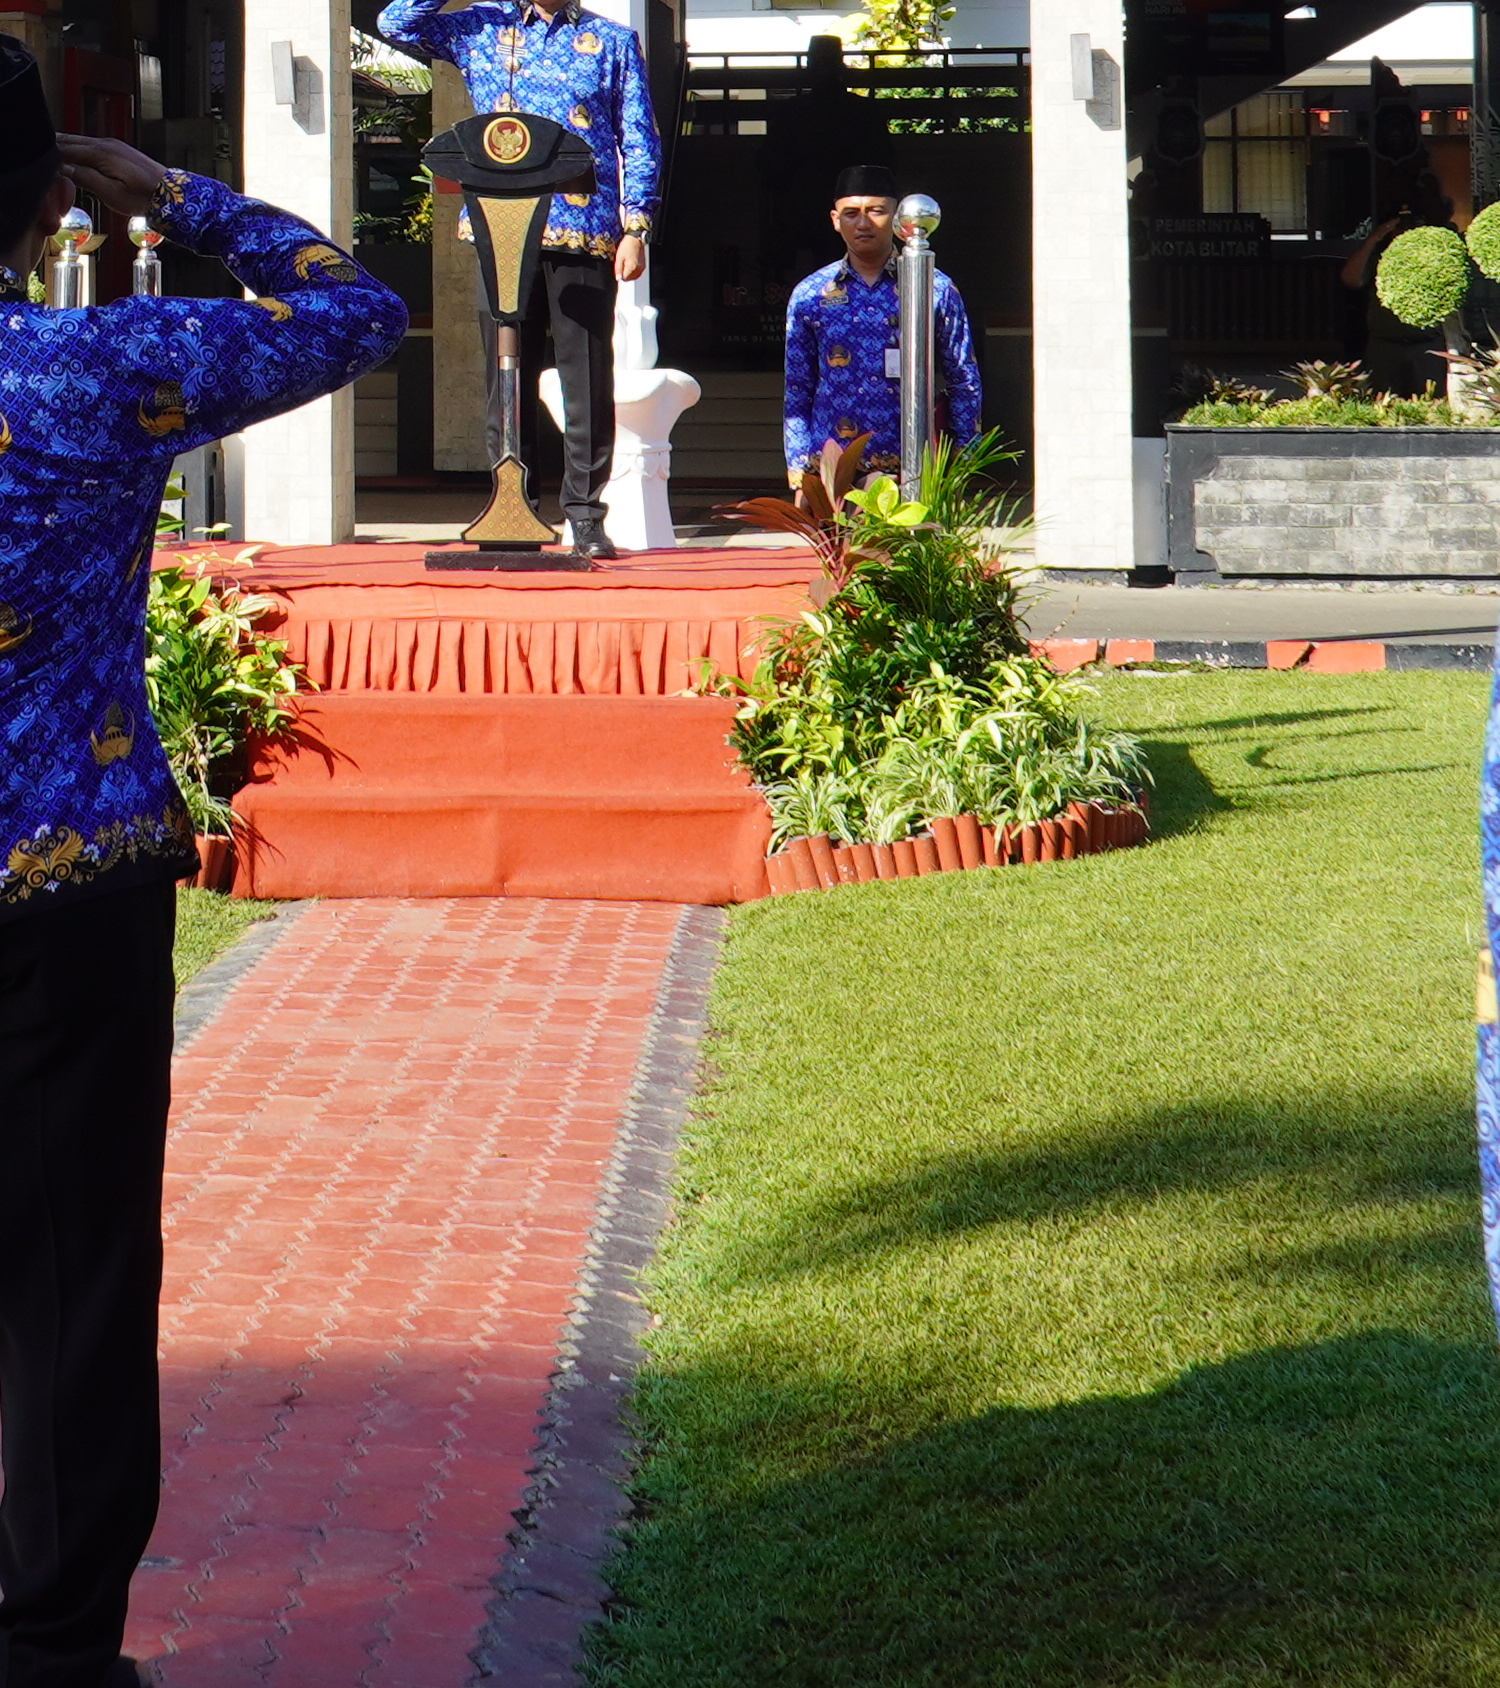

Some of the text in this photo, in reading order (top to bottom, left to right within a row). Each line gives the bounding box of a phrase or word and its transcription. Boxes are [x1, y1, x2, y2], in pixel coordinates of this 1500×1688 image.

[1154, 218, 1255, 233] PEMERINTAH
[1150, 240, 1259, 257] KOTA BLITAR
